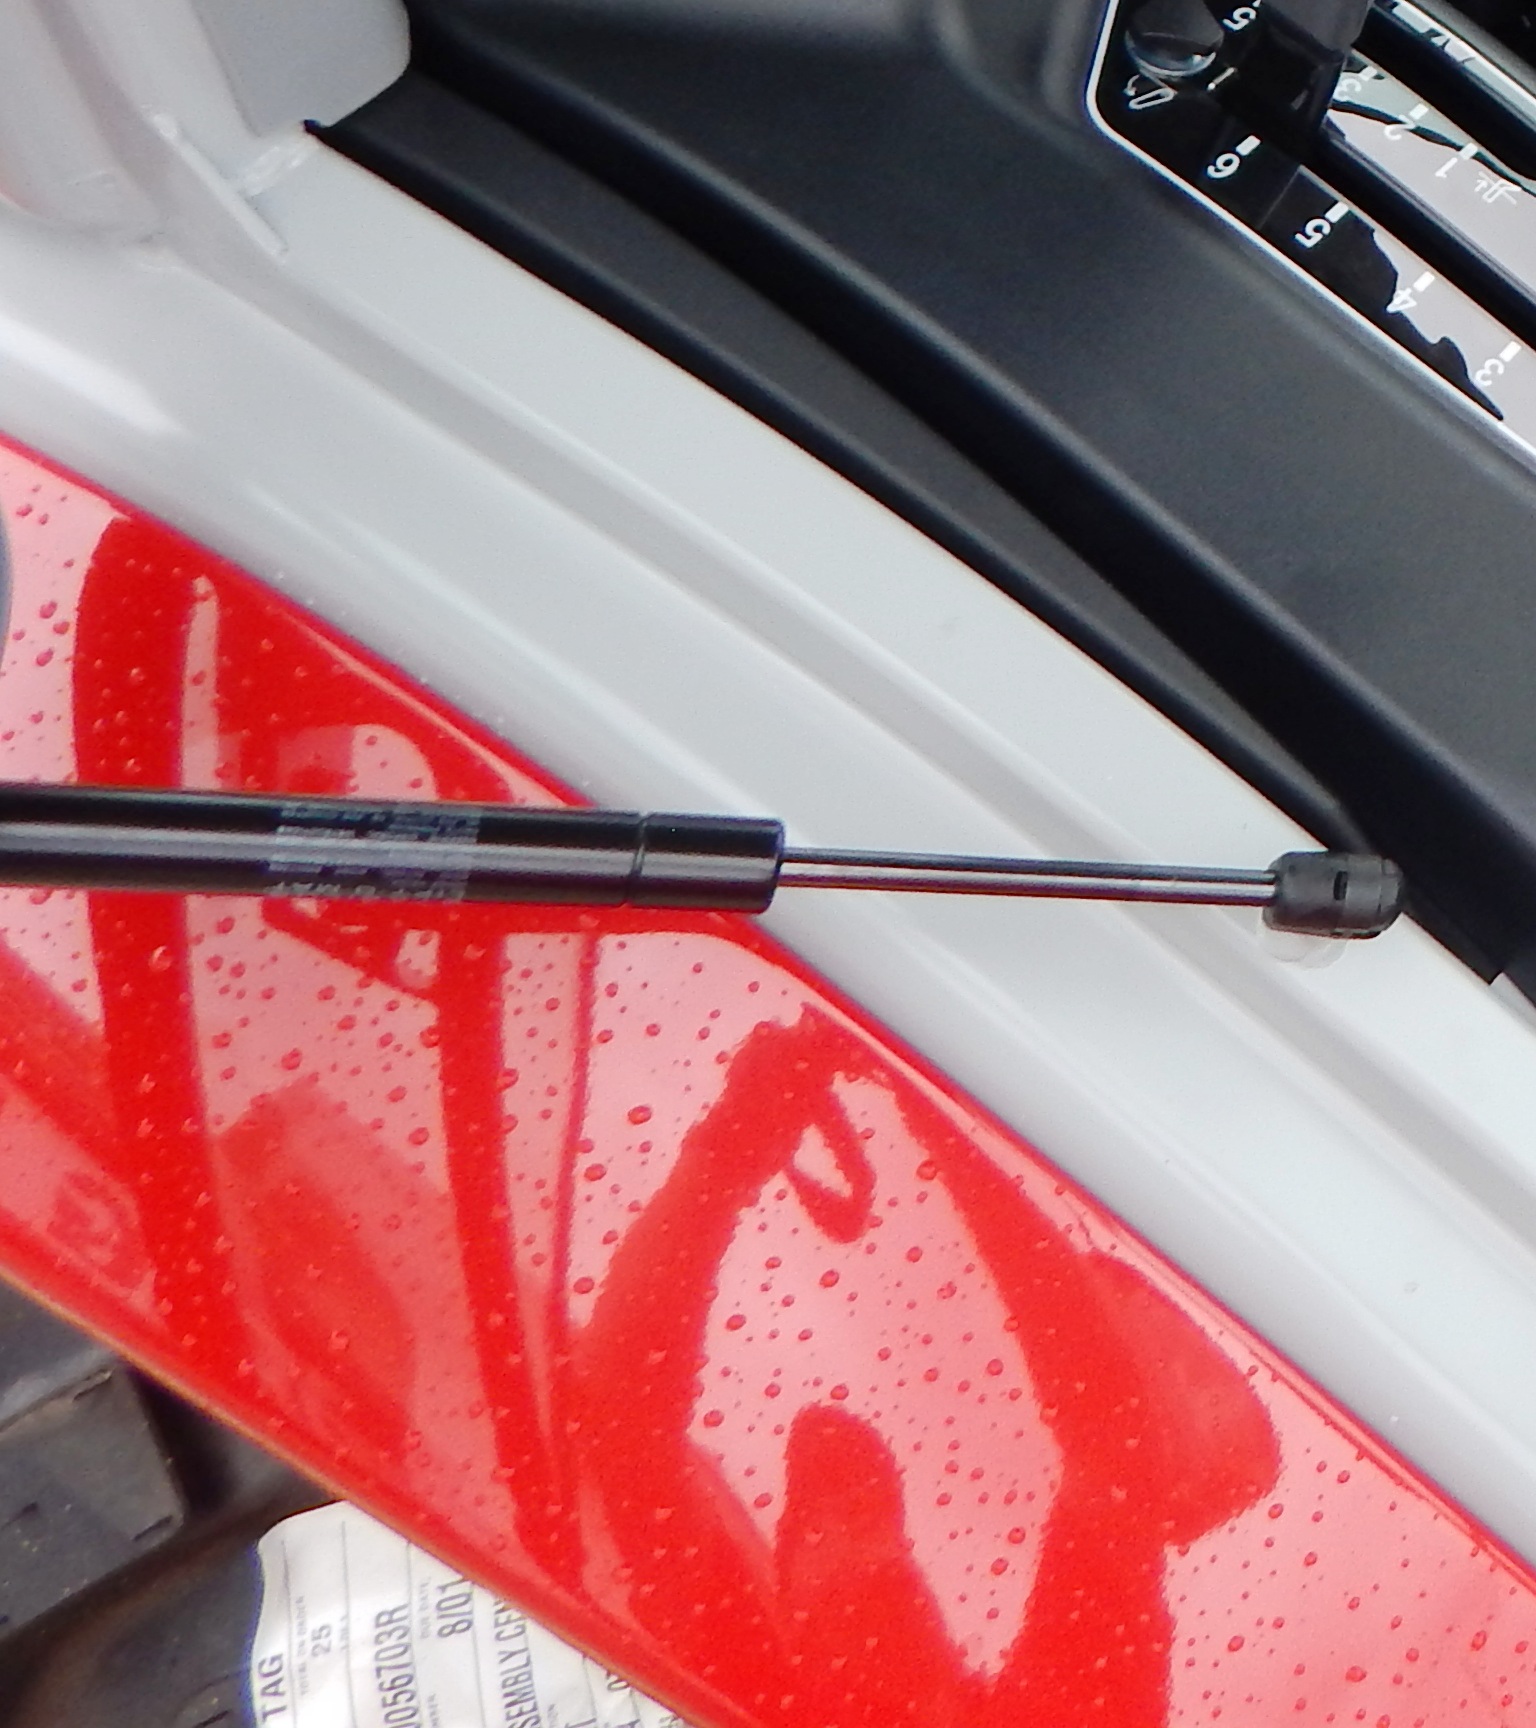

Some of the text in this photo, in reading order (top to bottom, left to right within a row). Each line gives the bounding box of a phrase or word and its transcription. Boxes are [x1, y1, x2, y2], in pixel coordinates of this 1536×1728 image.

[1222, 6, 1257, 31] 5
[1383, 114, 1416, 140] 2
[1206, 151, 1241, 179] 6
[1294, 218, 1332, 248] 5
[1386, 287, 1417, 313] 4
[1474, 357, 1505, 387] 3
[436, 1576, 473, 1638] 8/01
[311, 1623, 332, 1657] 25
[257, 1653, 288, 1723] TAG
